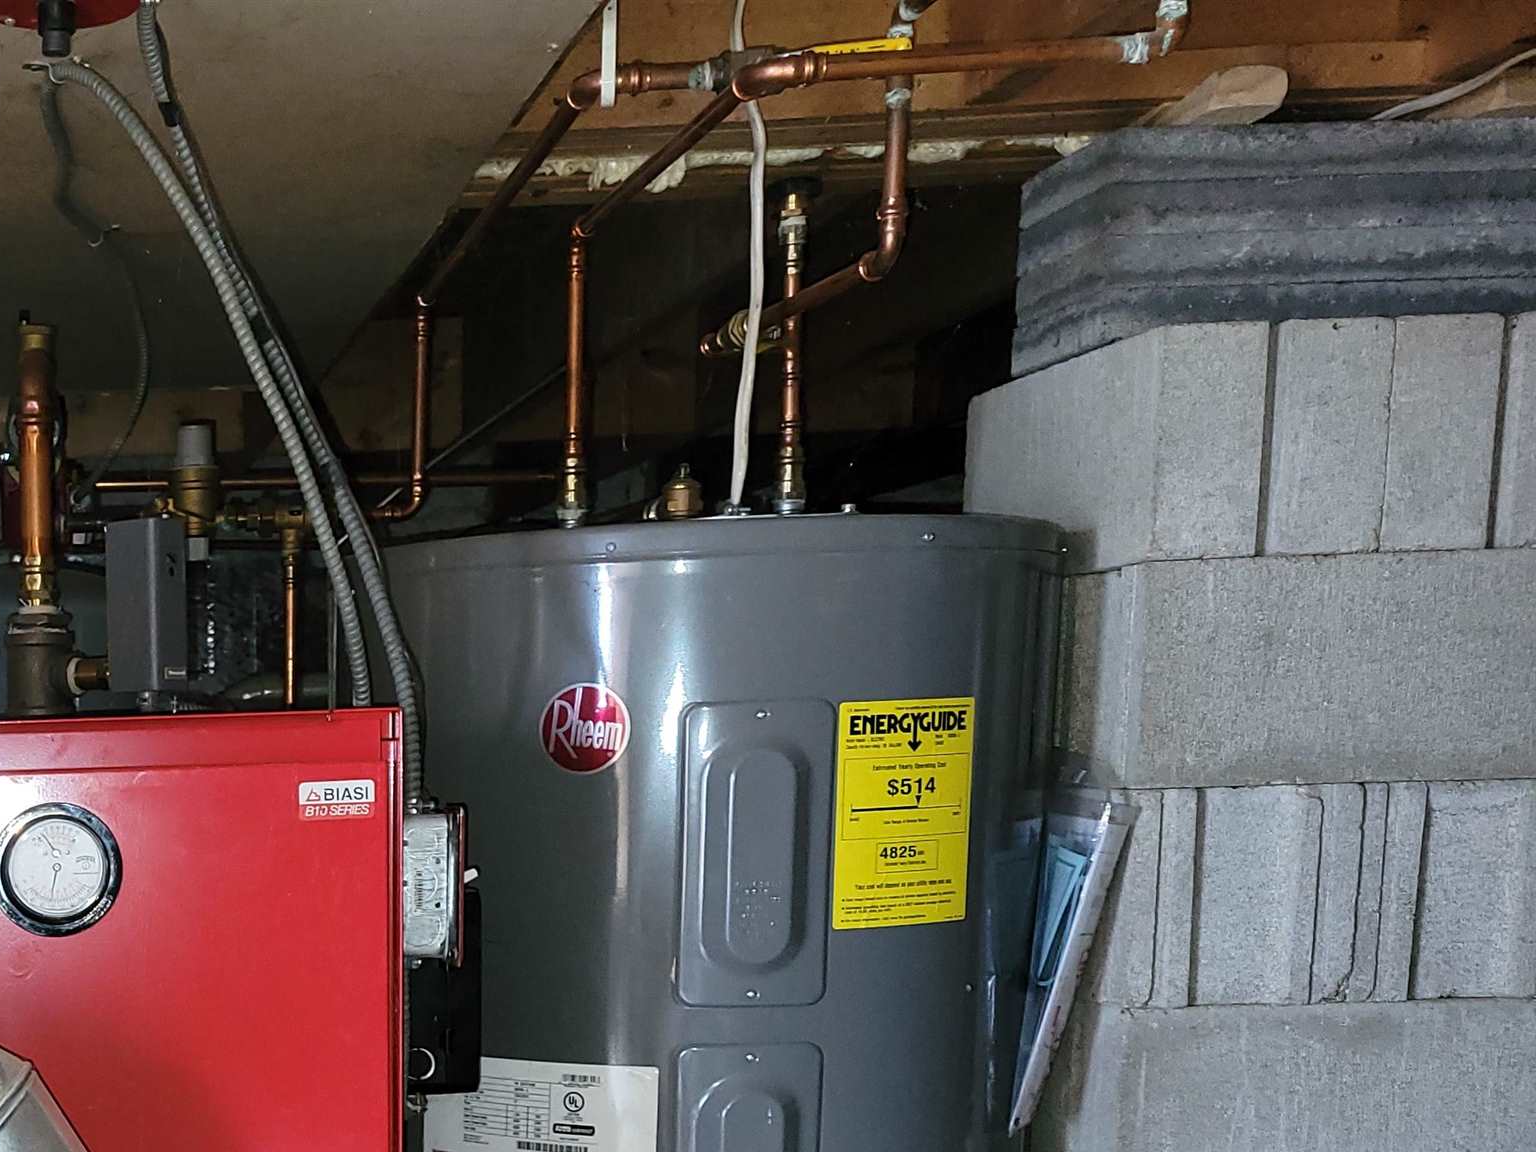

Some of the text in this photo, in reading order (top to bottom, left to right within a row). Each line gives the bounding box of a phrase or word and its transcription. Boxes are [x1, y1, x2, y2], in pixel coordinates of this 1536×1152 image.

[548, 687, 623, 759] Rheem
[849, 710, 967, 736] ENERGYGUIDE
[324, 786, 369, 801] BIASI
[887, 777, 936, 796] $514
[305, 804, 370, 817] B10 SERIES
[879, 846, 917, 859] 4825
